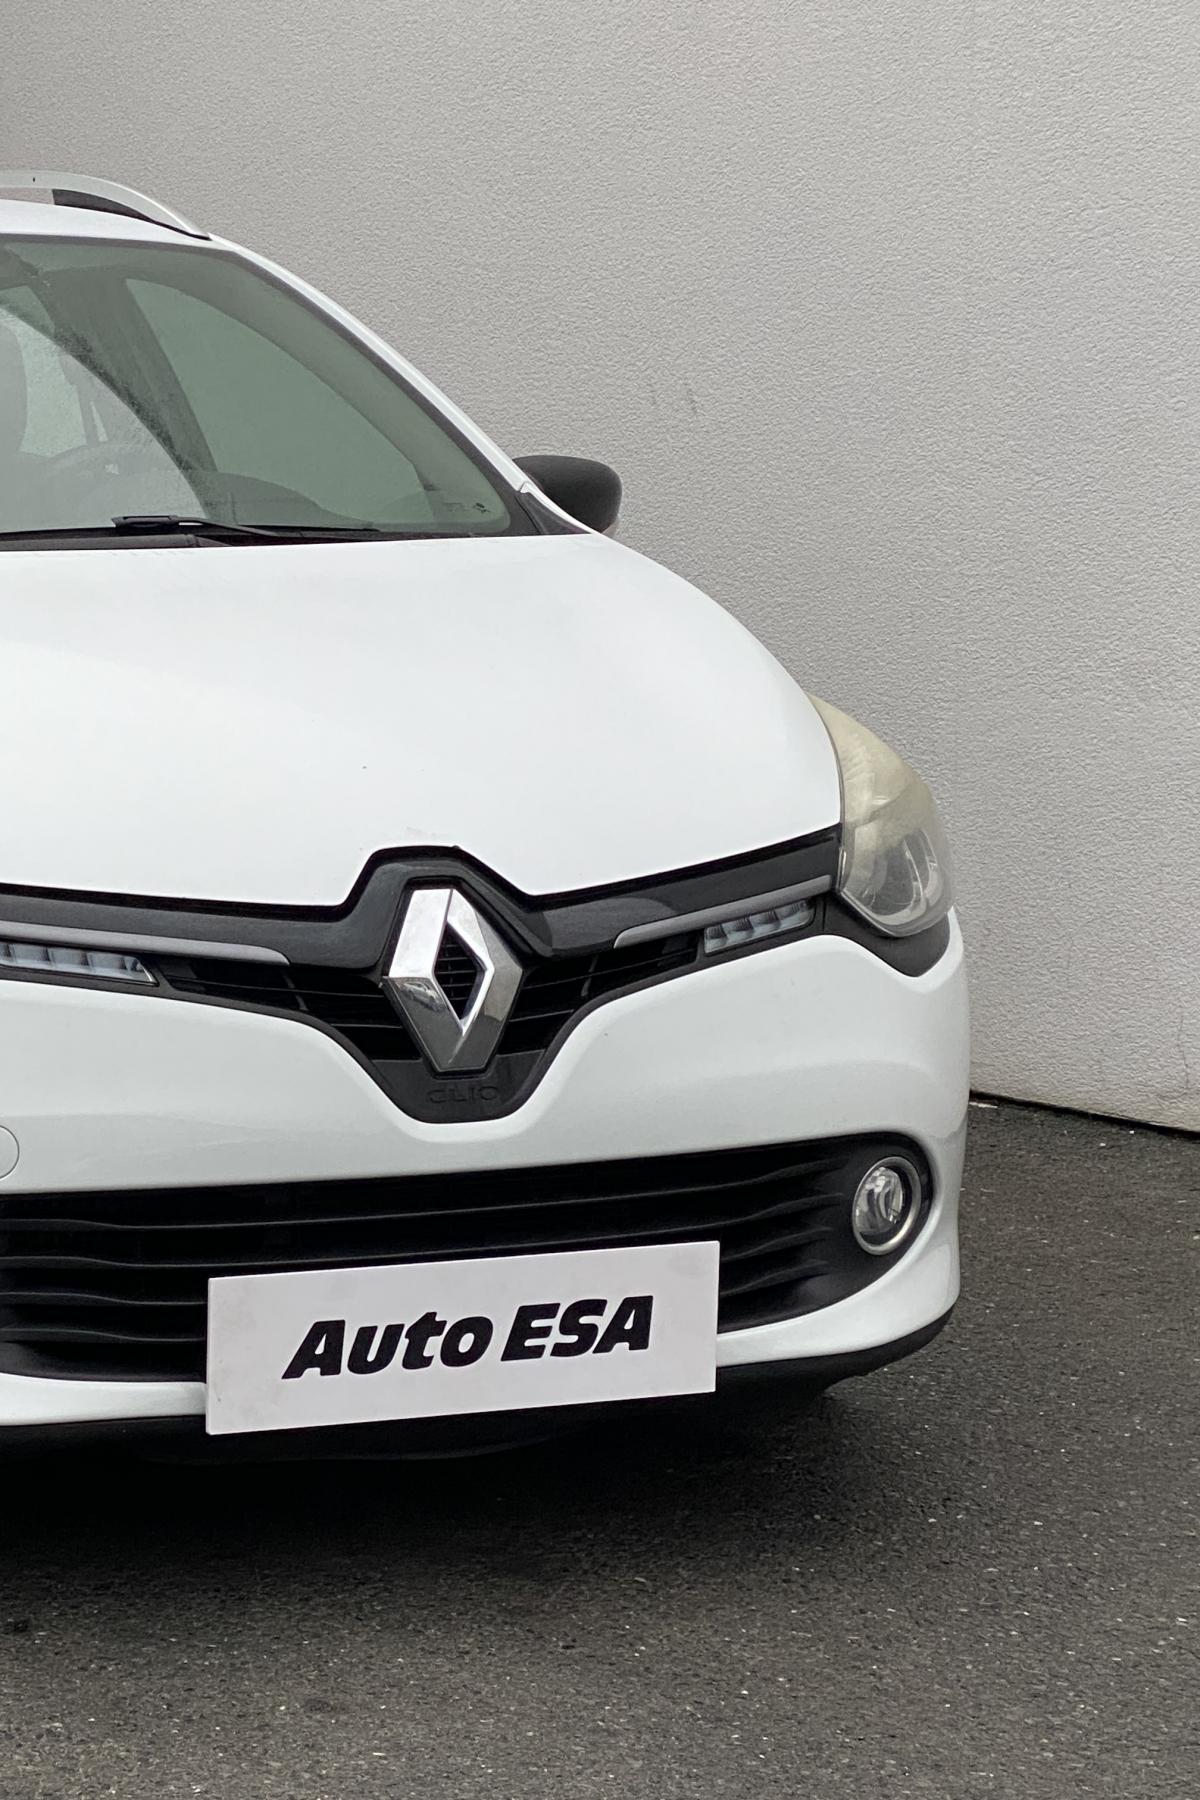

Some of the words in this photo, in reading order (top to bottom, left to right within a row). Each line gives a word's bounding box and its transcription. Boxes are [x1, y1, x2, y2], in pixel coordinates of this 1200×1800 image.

[426, 1086, 500, 1104] CLIO
[281, 1311, 494, 1380] Auto
[500, 1295, 654, 1362] ESA
